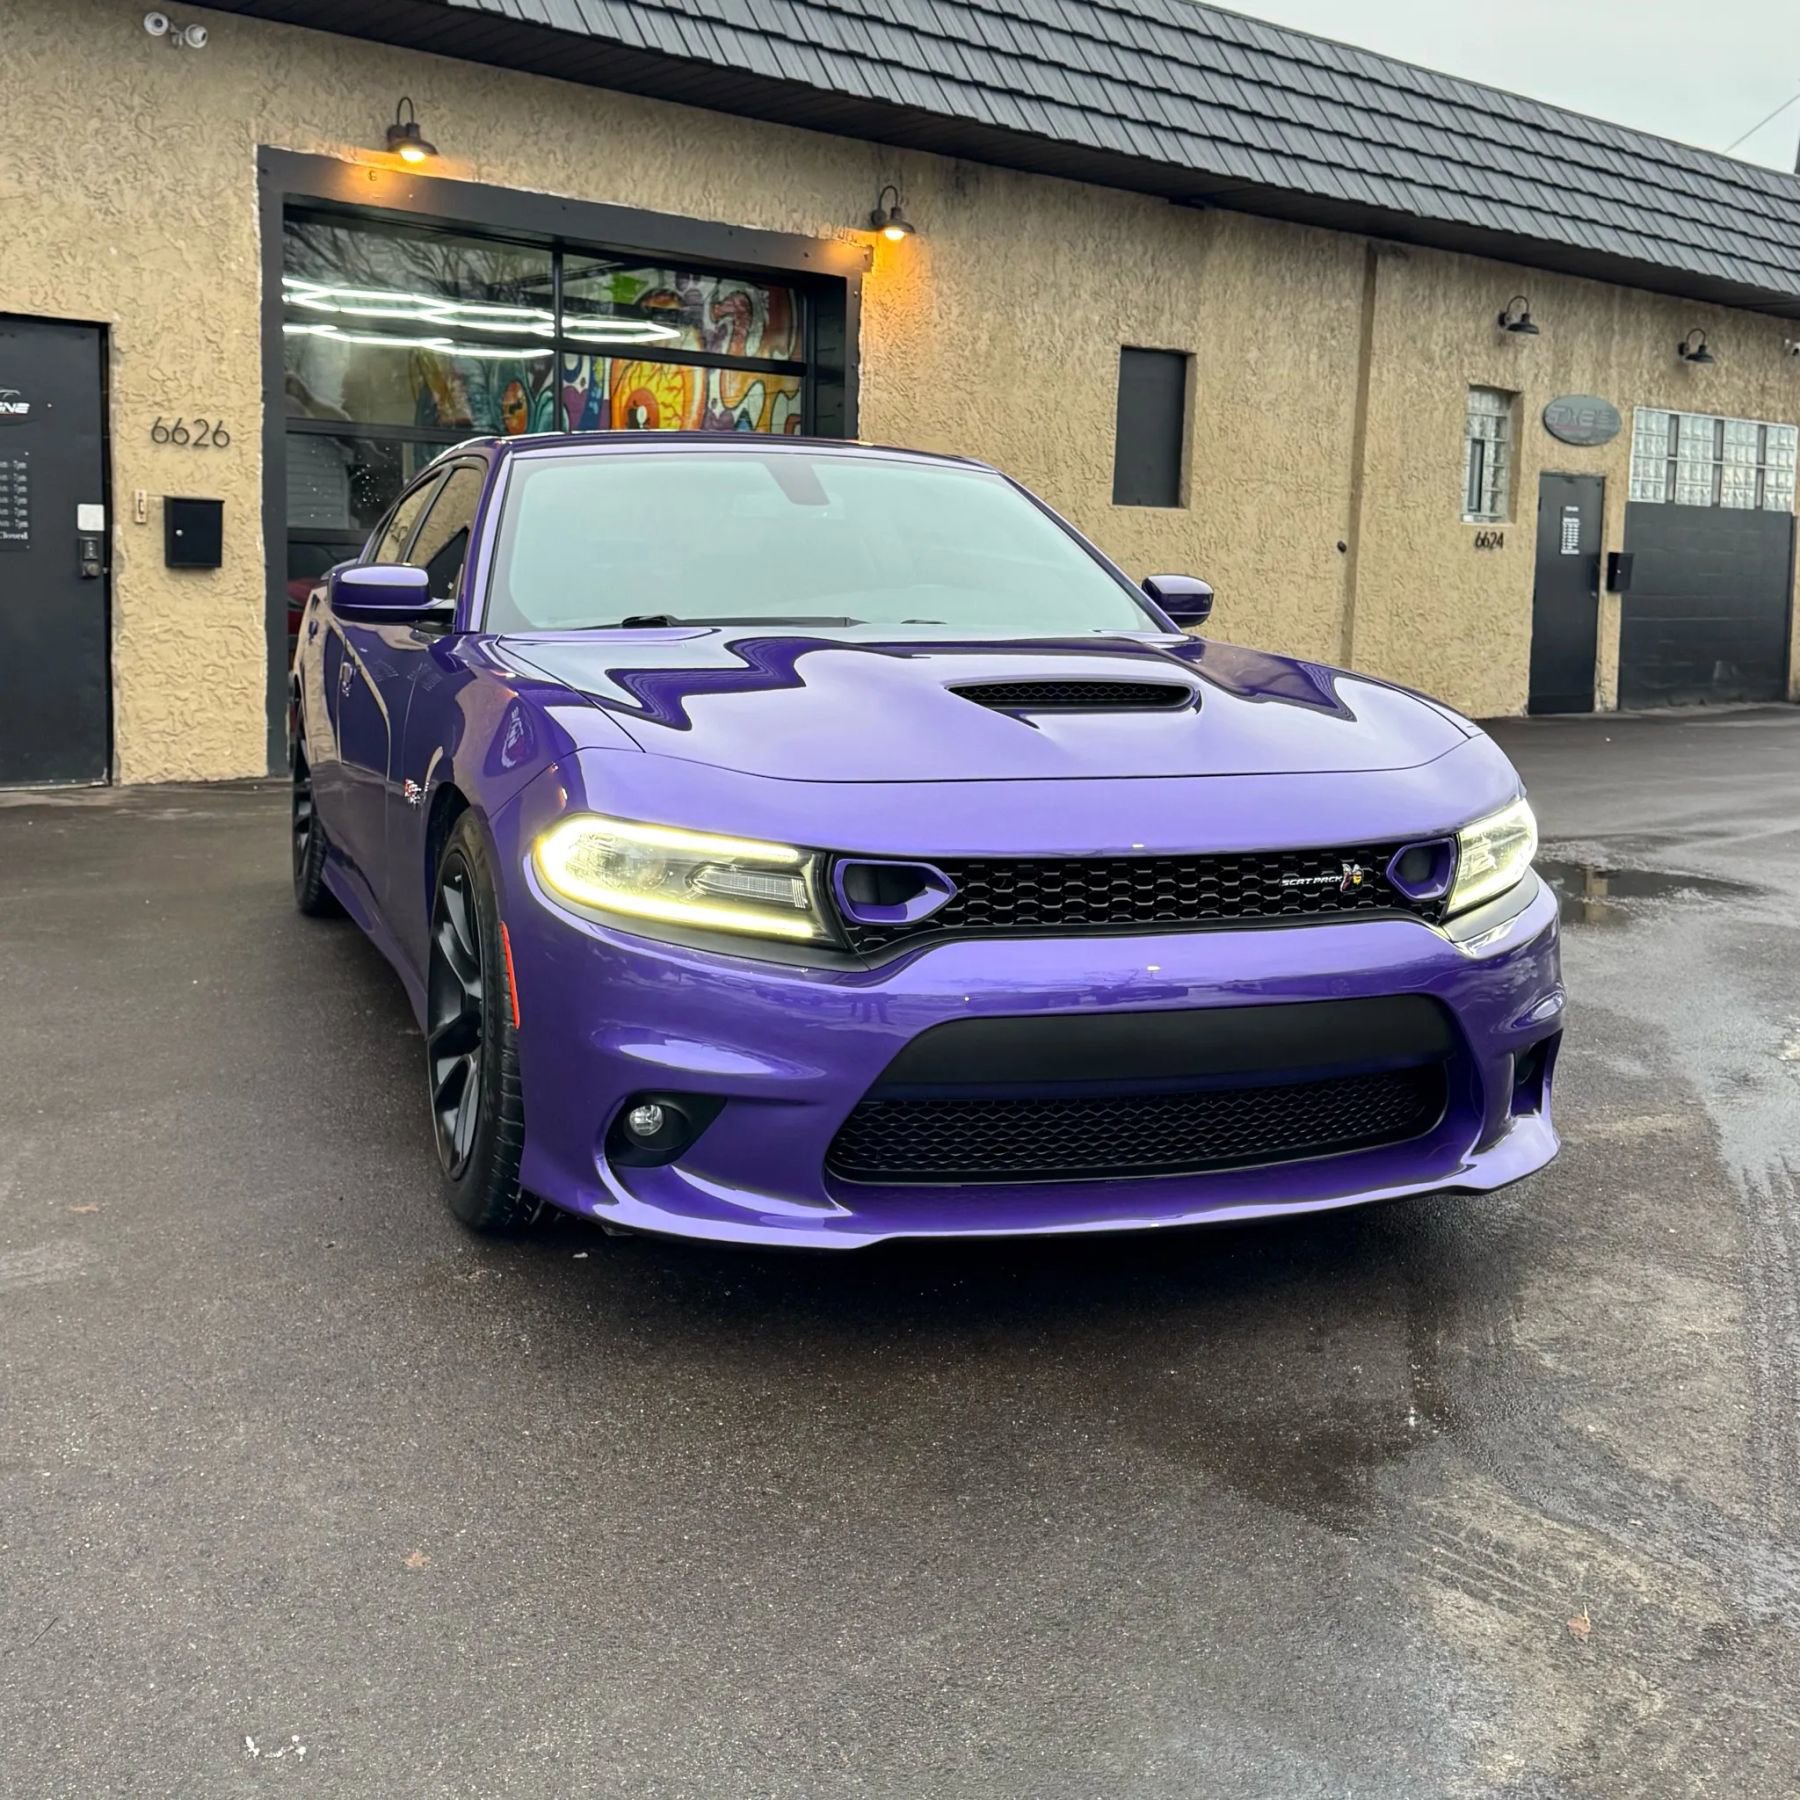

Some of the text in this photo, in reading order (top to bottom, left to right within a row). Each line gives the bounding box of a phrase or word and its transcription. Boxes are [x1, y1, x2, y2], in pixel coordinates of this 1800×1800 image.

[151, 416, 231, 449] 6626
[1475, 531, 1504, 550] 6624
[1281, 875, 1343, 887] SCAT PACK
